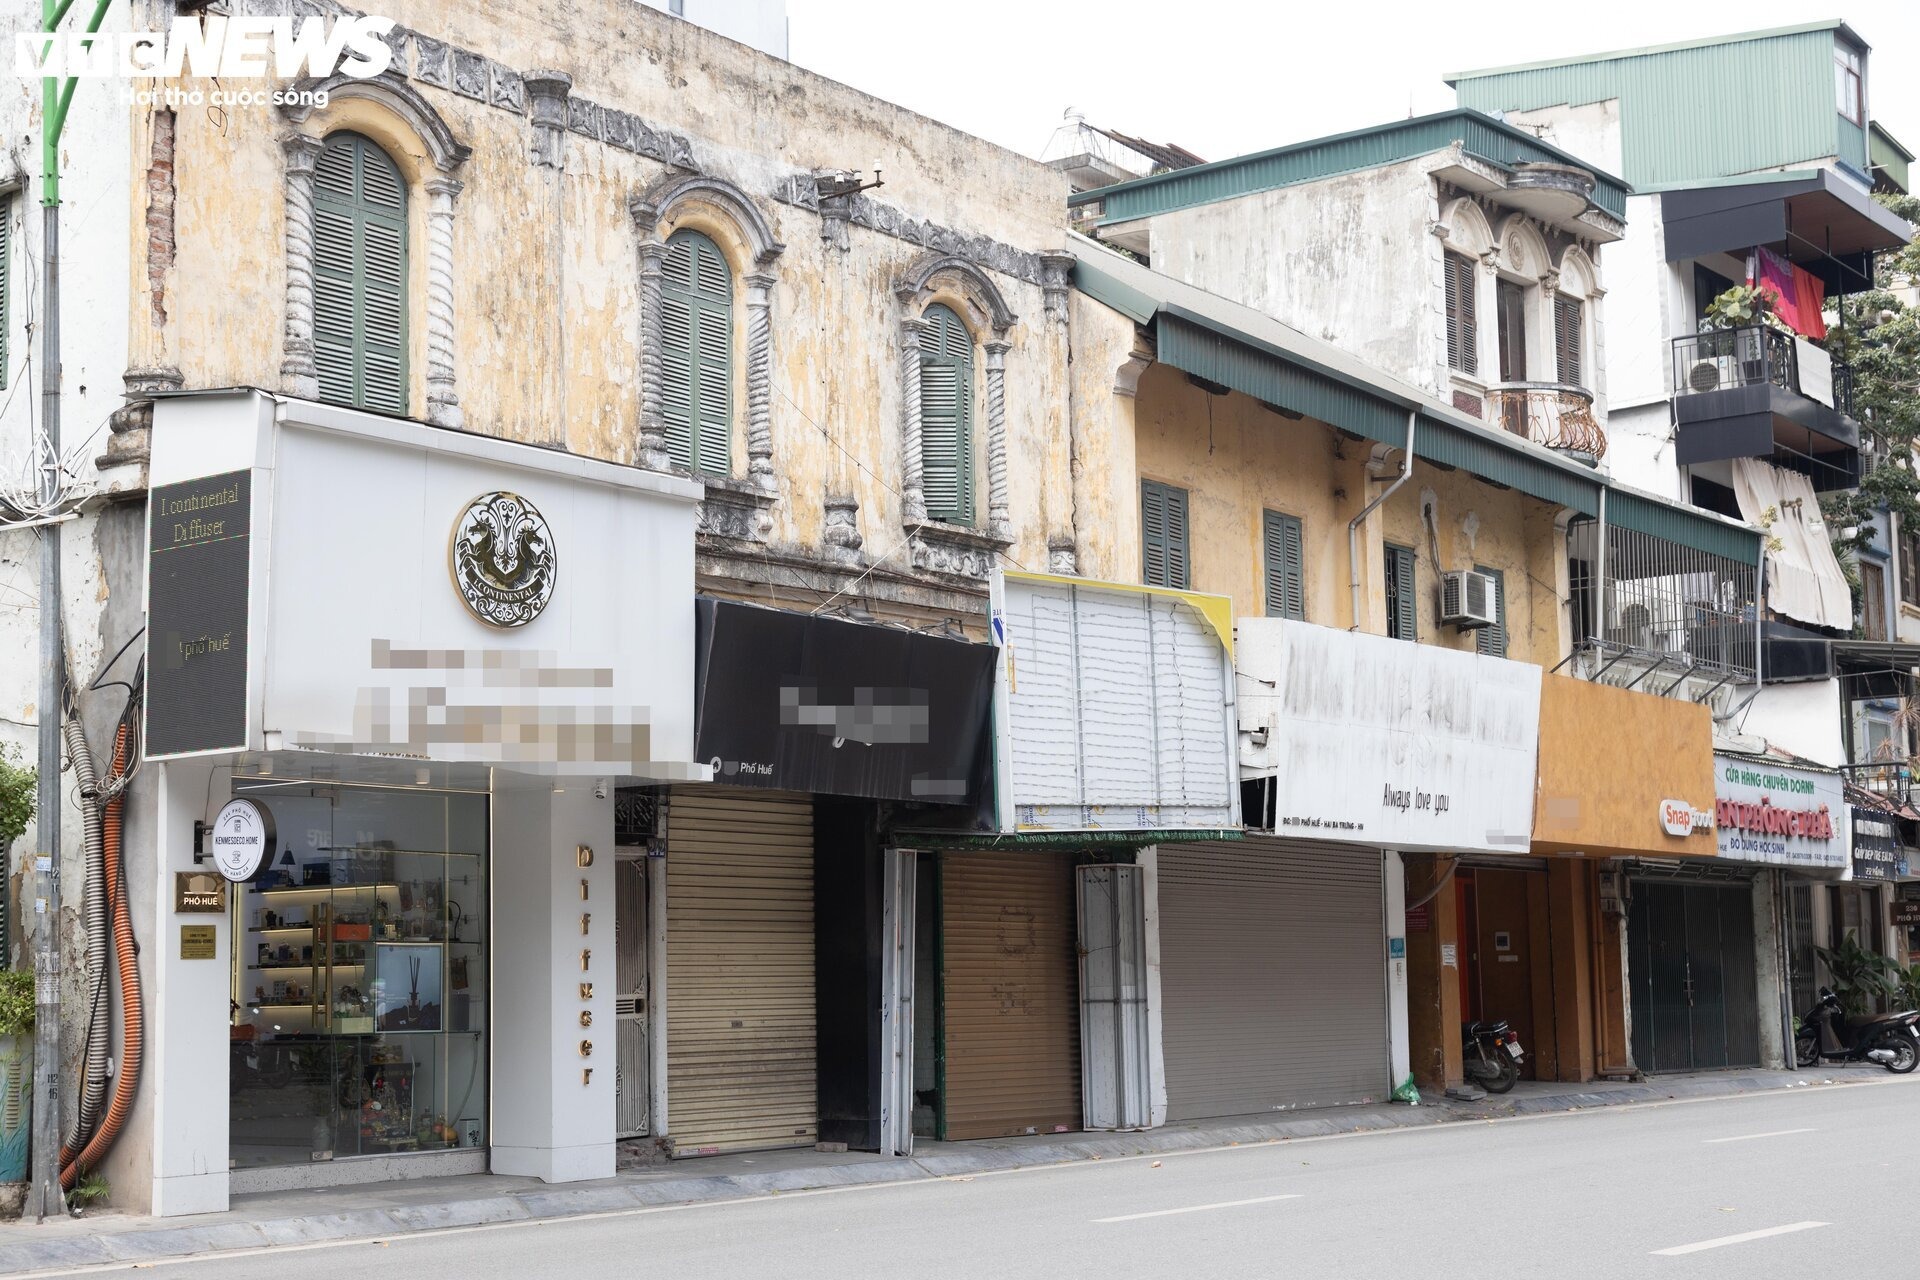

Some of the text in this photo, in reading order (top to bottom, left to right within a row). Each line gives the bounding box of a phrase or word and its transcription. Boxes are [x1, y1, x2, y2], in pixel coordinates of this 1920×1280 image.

[174, 518, 226, 543] Diffuser
[741, 762, 774, 775] Phố Huế
[1725, 764, 1815, 795] CỬA HÀNG CHUYÊN DOANH
[1383, 783, 1449, 816] Always love you
[1666, 804, 1690, 831] Snap
[1772, 844, 1785, 855] SINH
[576, 845, 594, 1086] Diffuser
